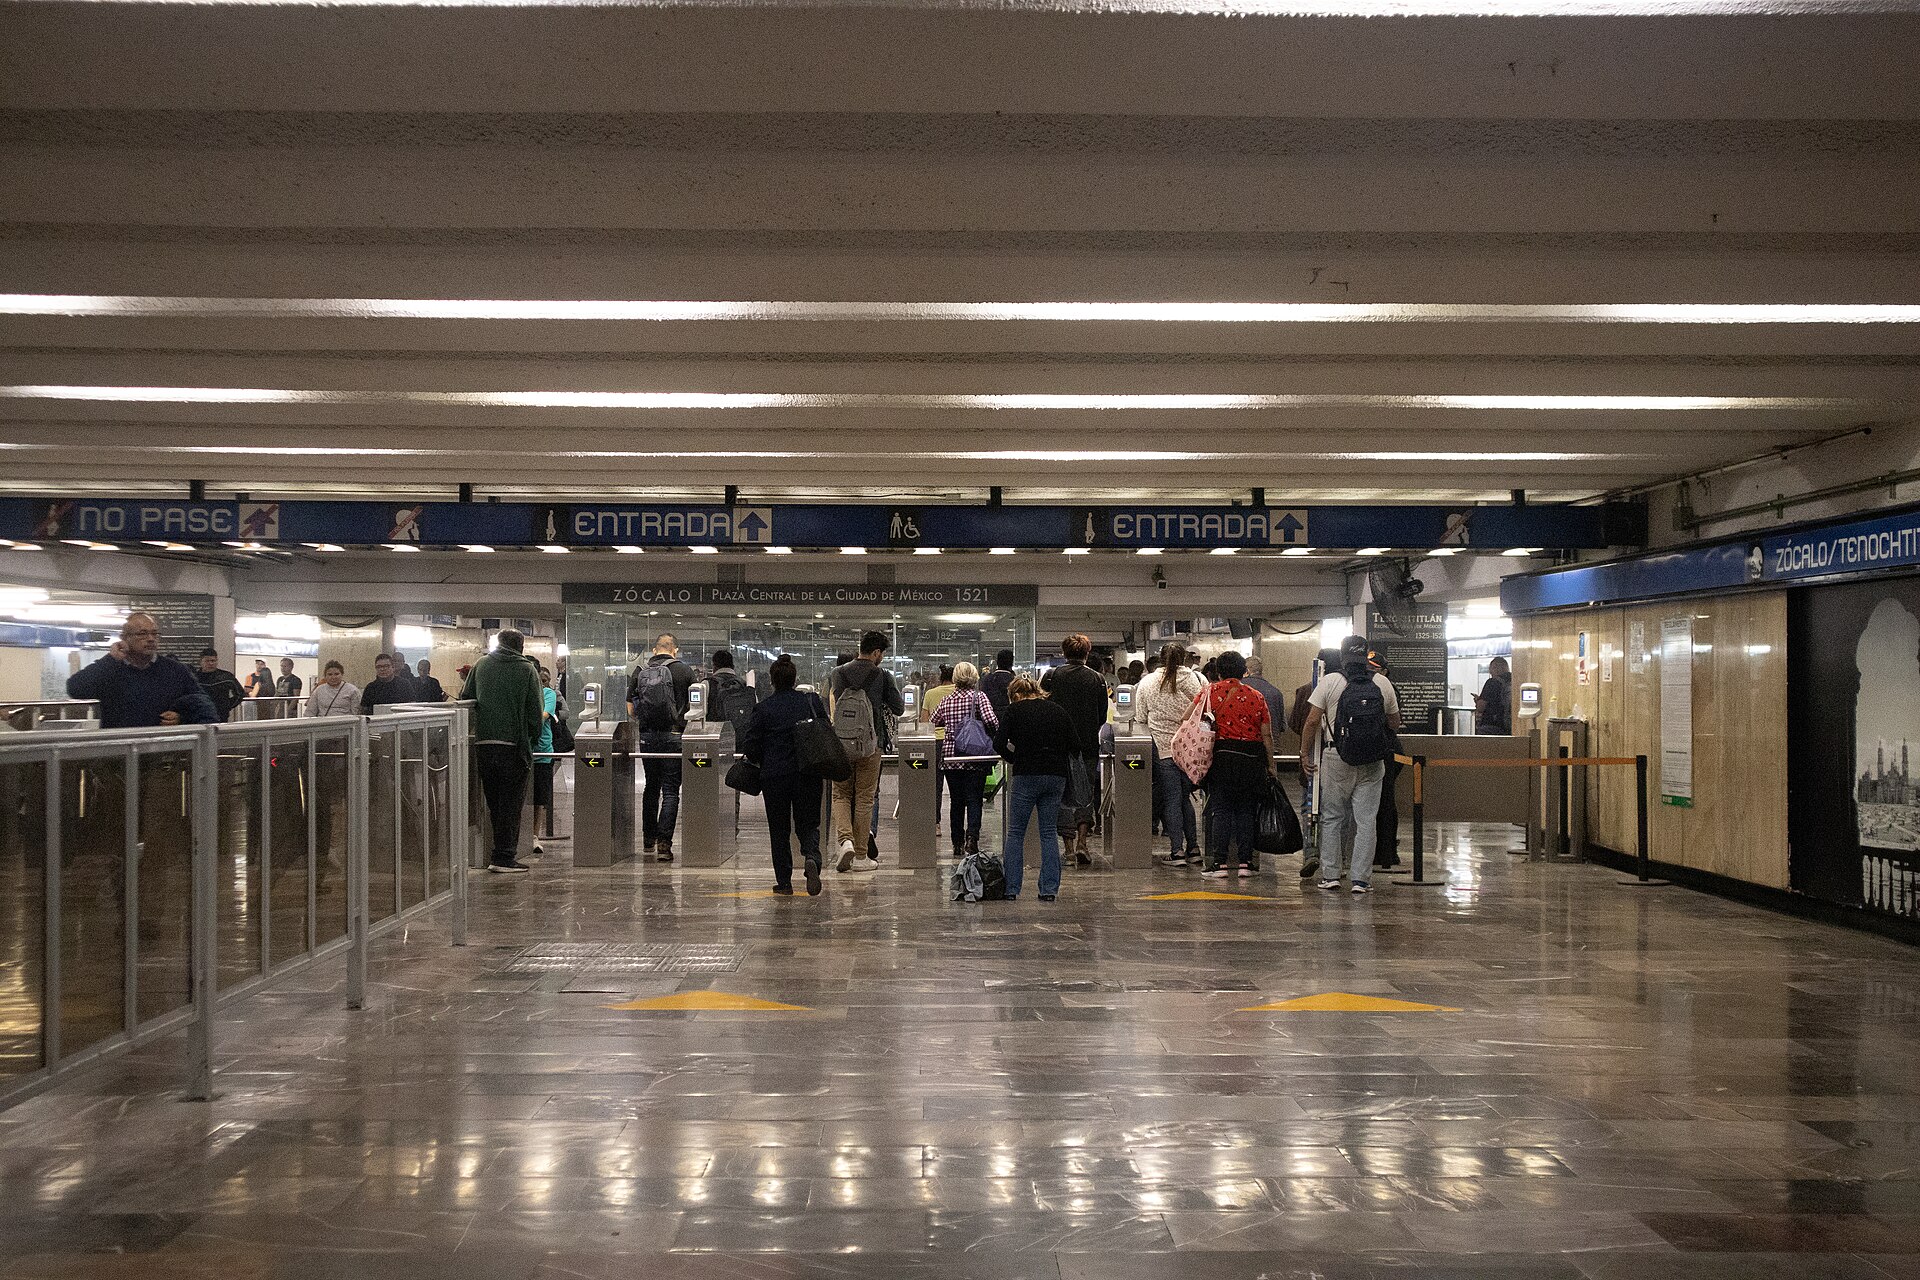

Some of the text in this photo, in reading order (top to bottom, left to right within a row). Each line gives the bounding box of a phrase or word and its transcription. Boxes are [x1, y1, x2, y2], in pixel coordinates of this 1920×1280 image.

[79, 507, 232, 533] NO PASE
[575, 511, 731, 537] ENTRADA
[1113, 514, 1268, 539] ENTRADA
[613, 586, 691, 602] ZÓCALO
[955, 587, 989, 602] 1521
